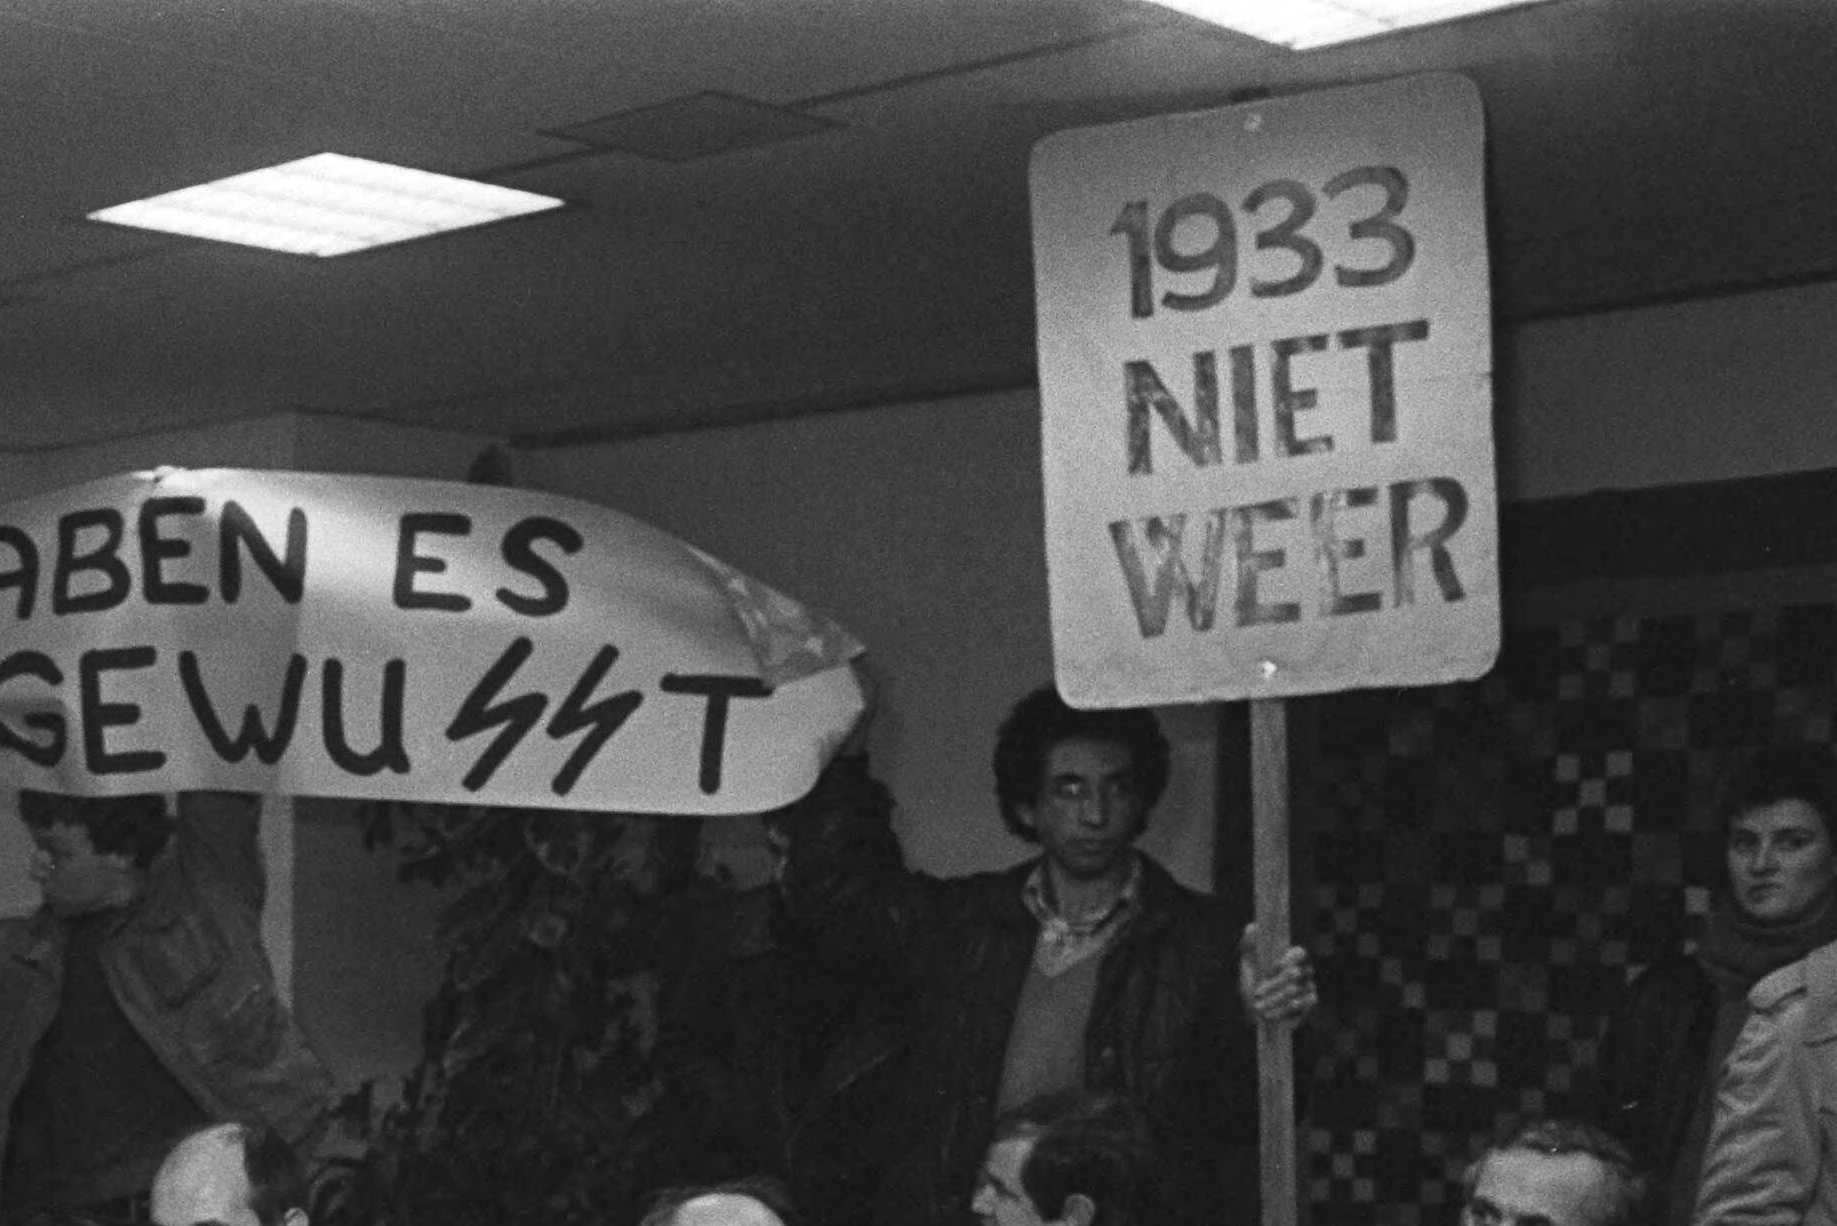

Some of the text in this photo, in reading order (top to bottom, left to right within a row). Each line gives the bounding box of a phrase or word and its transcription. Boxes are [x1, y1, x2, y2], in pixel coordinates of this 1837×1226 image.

[1109, 165, 1416, 319] 1933
[1124, 318, 1430, 475] NIET
[393, 511, 584, 615] ES
[1108, 476, 1469, 639] WEER
